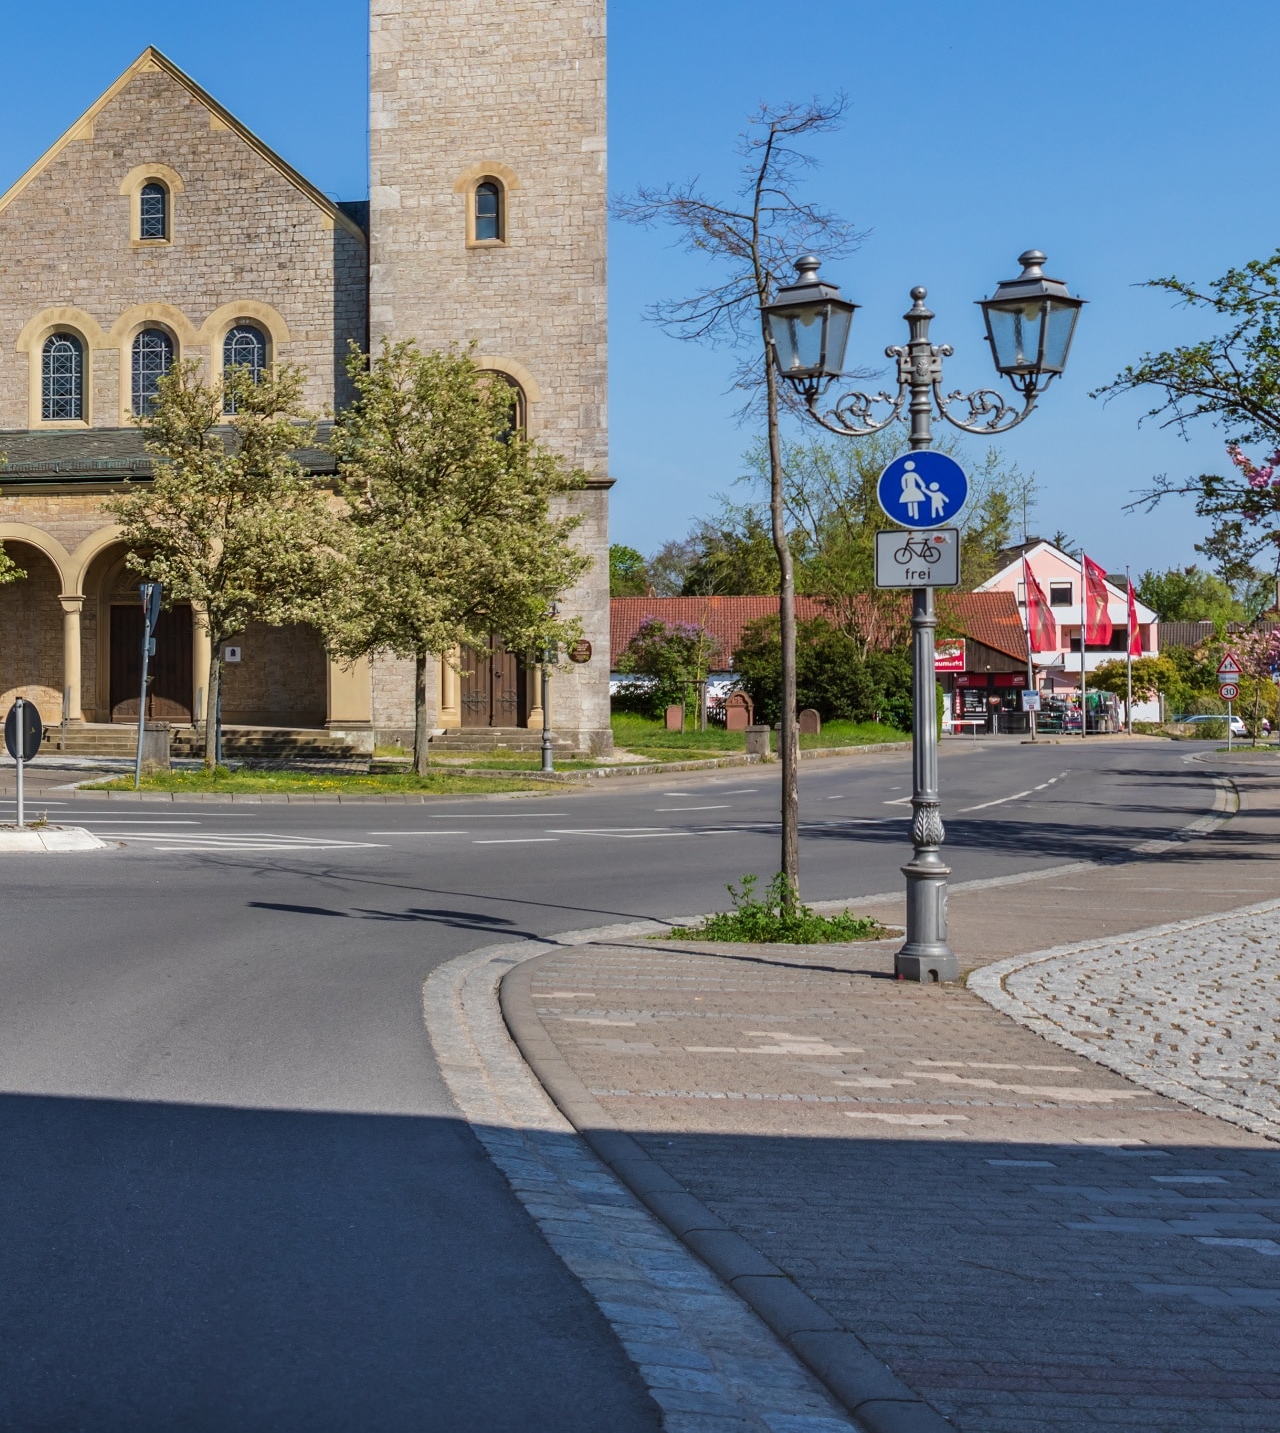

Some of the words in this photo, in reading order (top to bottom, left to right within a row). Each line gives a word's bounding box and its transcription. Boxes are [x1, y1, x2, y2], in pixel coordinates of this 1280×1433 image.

[905, 567, 931, 580] frei
[934, 659, 963, 667] aumarkt
[1223, 688, 1235, 696] 30
